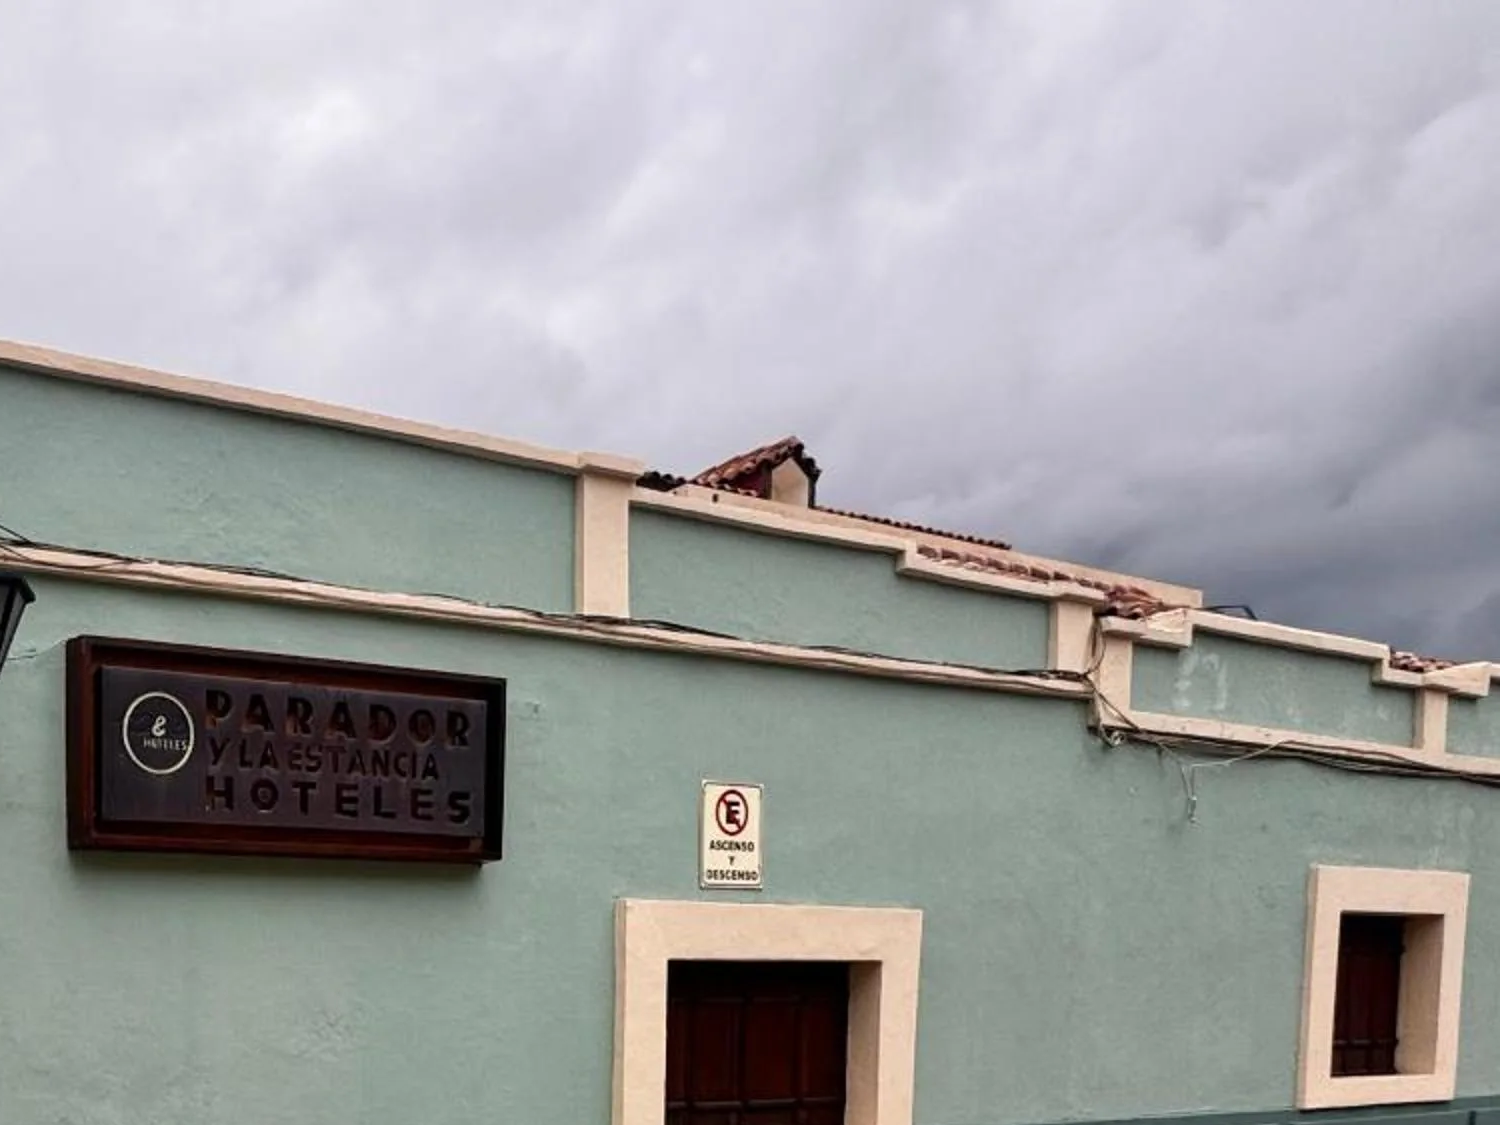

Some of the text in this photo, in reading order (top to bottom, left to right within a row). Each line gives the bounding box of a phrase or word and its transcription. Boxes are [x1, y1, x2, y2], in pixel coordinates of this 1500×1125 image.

[206, 690, 471, 747] PARADOR
[208, 739, 228, 766] Y
[288, 744, 438, 781] ESTANCIA
[206, 776, 471, 823] HOTELES
[709, 840, 754, 852] ASCENSO
[706, 869, 758, 880] DESCENSO
[728, 856, 735, 866] Y
